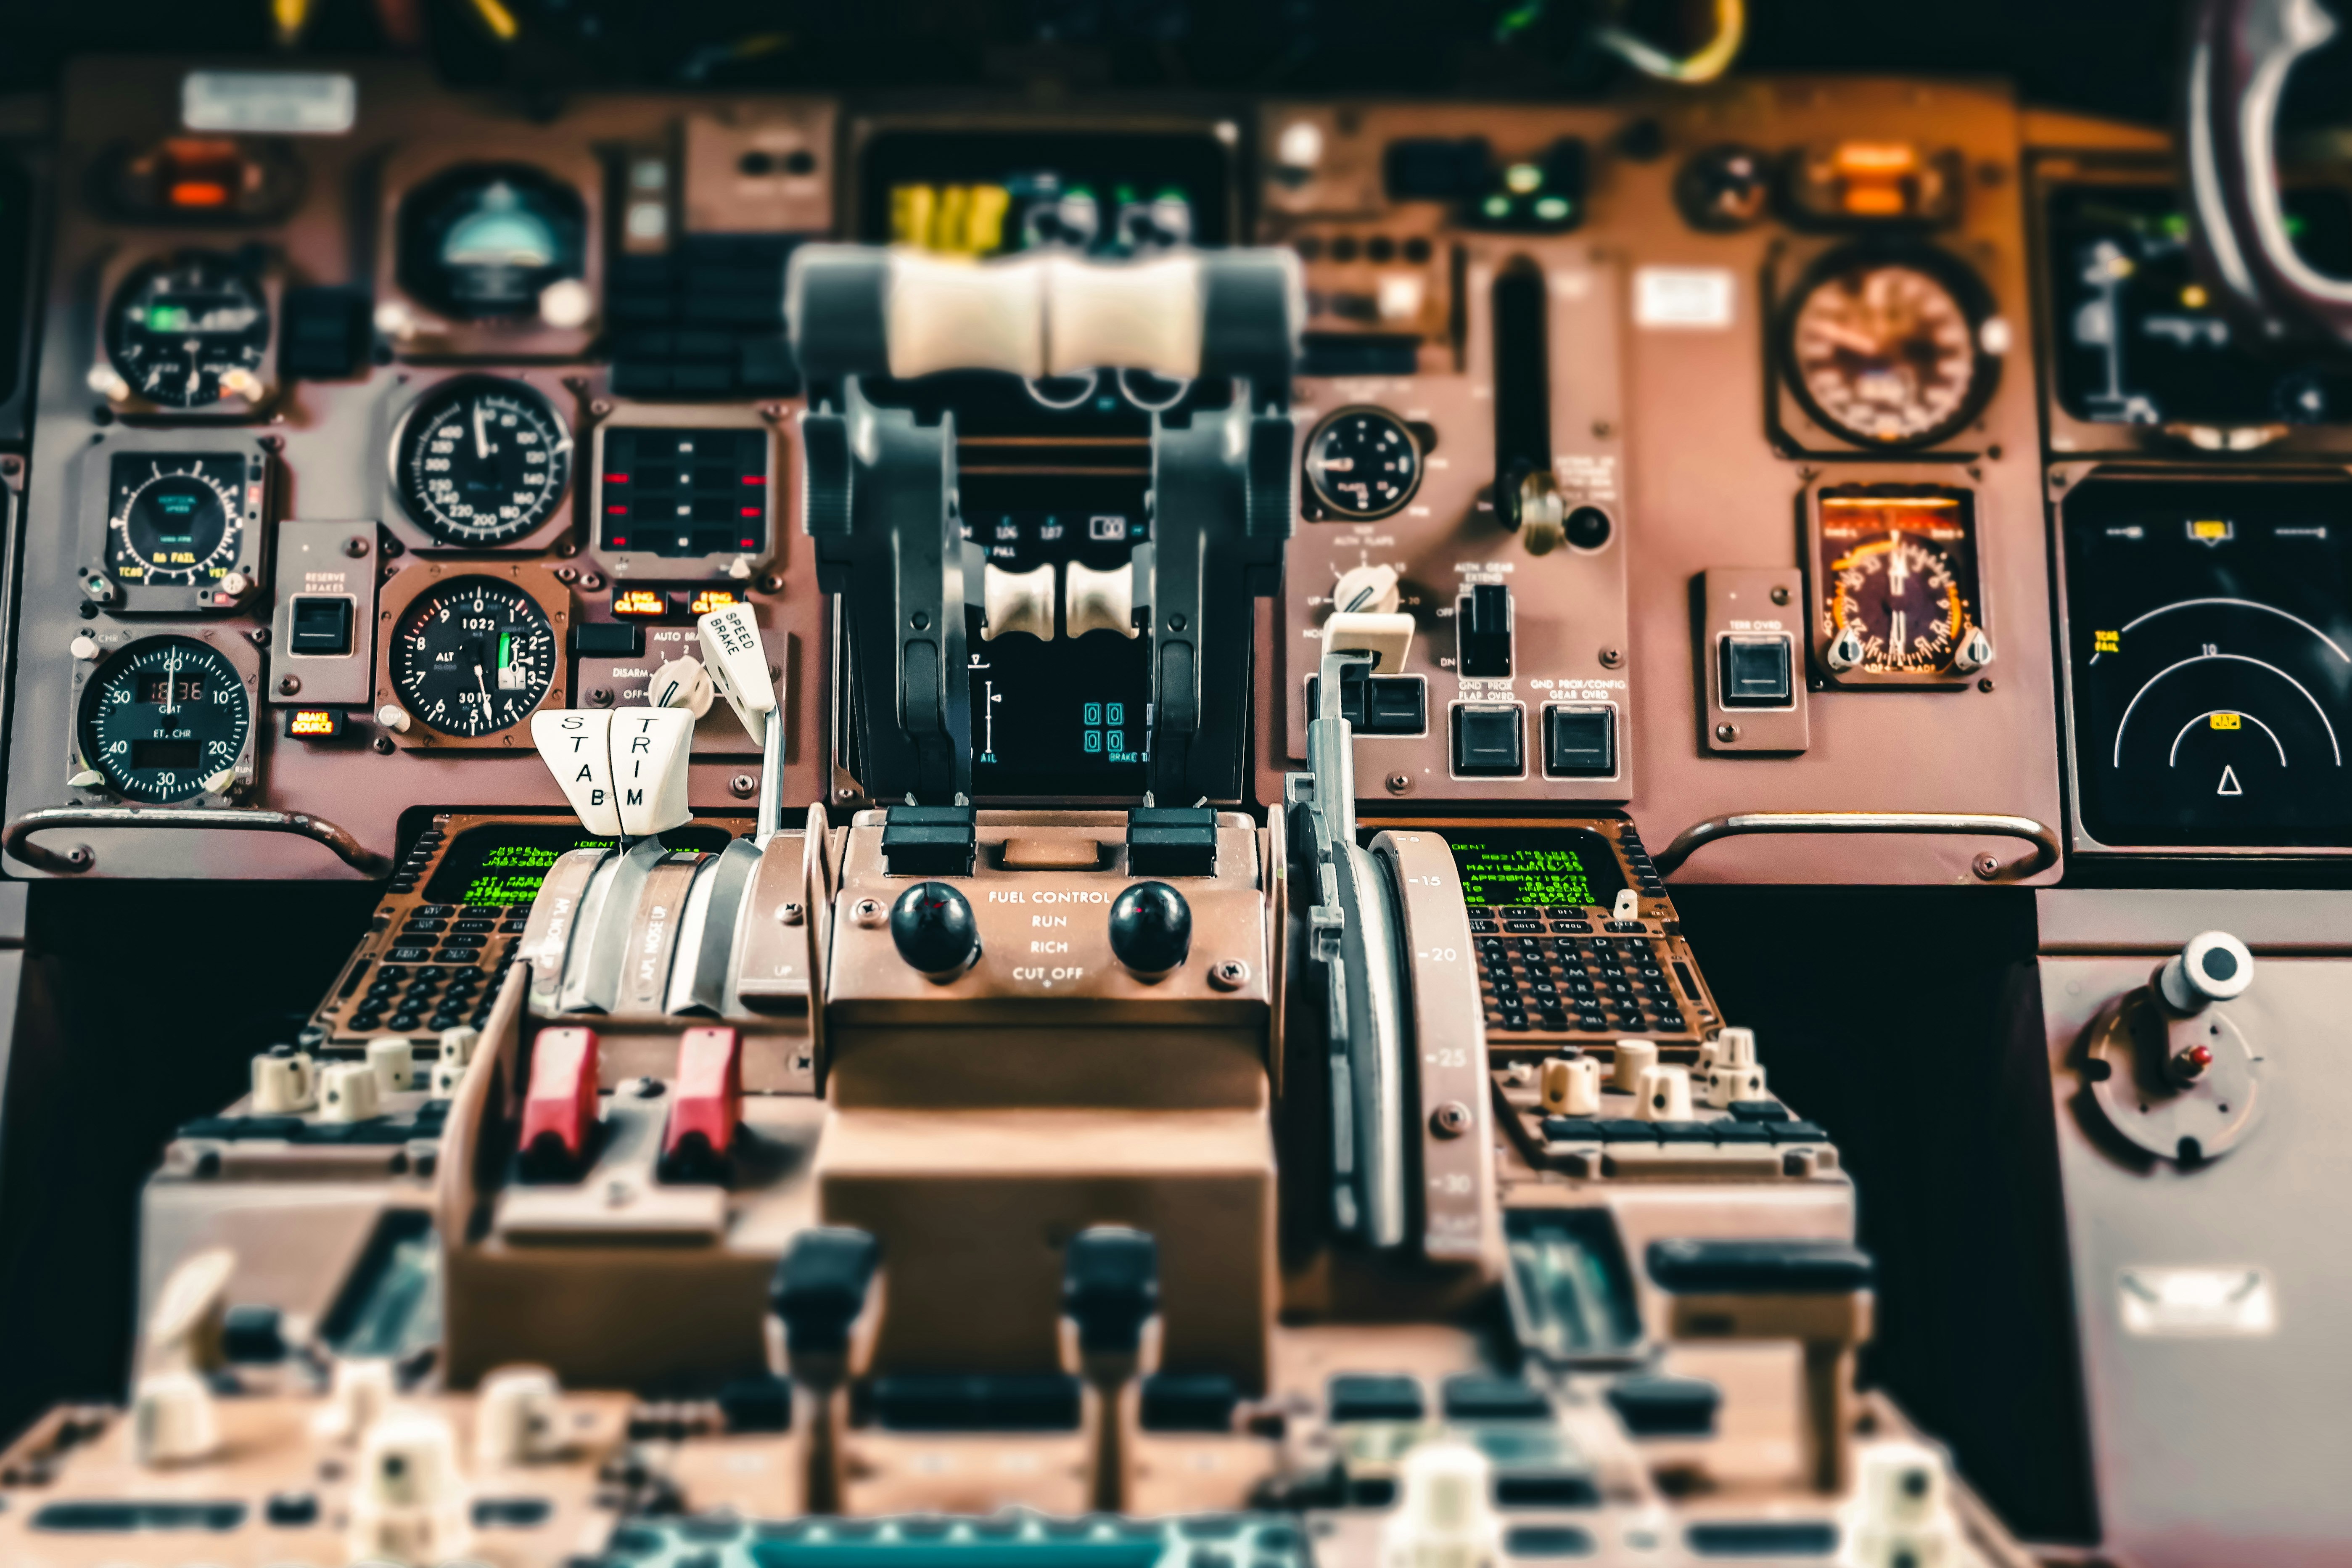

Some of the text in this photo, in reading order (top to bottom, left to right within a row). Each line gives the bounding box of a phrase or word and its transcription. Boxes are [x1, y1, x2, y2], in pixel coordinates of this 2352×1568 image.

[449, 505, 473, 518] 220
[473, 514, 497, 526] 200
[305, 572, 346, 582] RESERVE
[305, 584, 344, 592] BRAKES
[473, 599, 484, 613] 0
[1436, 608, 1454, 617] OFF
[440, 609, 450, 623] 9
[510, 609, 514, 623] 1
[462, 618, 495, 631] 1022
[726, 612, 755, 649] SPEED
[511, 636, 521, 649] 2
[529, 635, 538, 650] 2
[654, 632, 682, 641] AUTO
[711, 618, 740, 656] BRAKE
[417, 637, 426, 650] 8
[683, 645, 689, 654] 2
[436, 652, 455, 662] ALT
[1440, 658, 1455, 666] DN
[509, 660, 520, 674] 0
[613, 668, 649, 677] DISARM
[416, 671, 426, 685] 7
[527, 671, 536, 685] 3
[1530, 680, 1554, 689] GND
[1459, 681, 1512, 690] GND PROX
[113, 691, 130, 704] 50
[213, 691, 229, 704] 10
[1459, 691, 1514, 701] FLAP OVRD
[1549, 690, 1608, 700] GEAR OVRD
[435, 698, 445, 713] 6
[504, 698, 513, 711] 4
[296, 712, 329, 722] BRAKE
[469, 709, 478, 723] 5
[172, 729, 191, 738] CHR
[292, 721, 334, 734] SOURCE
[108, 740, 127, 754] 40
[208, 741, 227, 754] 20
[561, 716, 605, 806] STAB
[627, 718, 659, 806] TRIM
[980, 753, 997, 762] AIL
[156, 772, 176, 786] 30
[1422, 875, 1441, 886] 15
[988, 891, 1111, 904] FUEL CONTROL
[1032, 915, 1067, 928] RUN
[644, 920, 664, 954] NOSE
[1031, 941, 1068, 953] RICH
[1432, 947, 1457, 962] 20
[774, 965, 792, 976] UP
[1012, 967, 1084, 980] CUT OFF
[1439, 1048, 1467, 1068] 25
